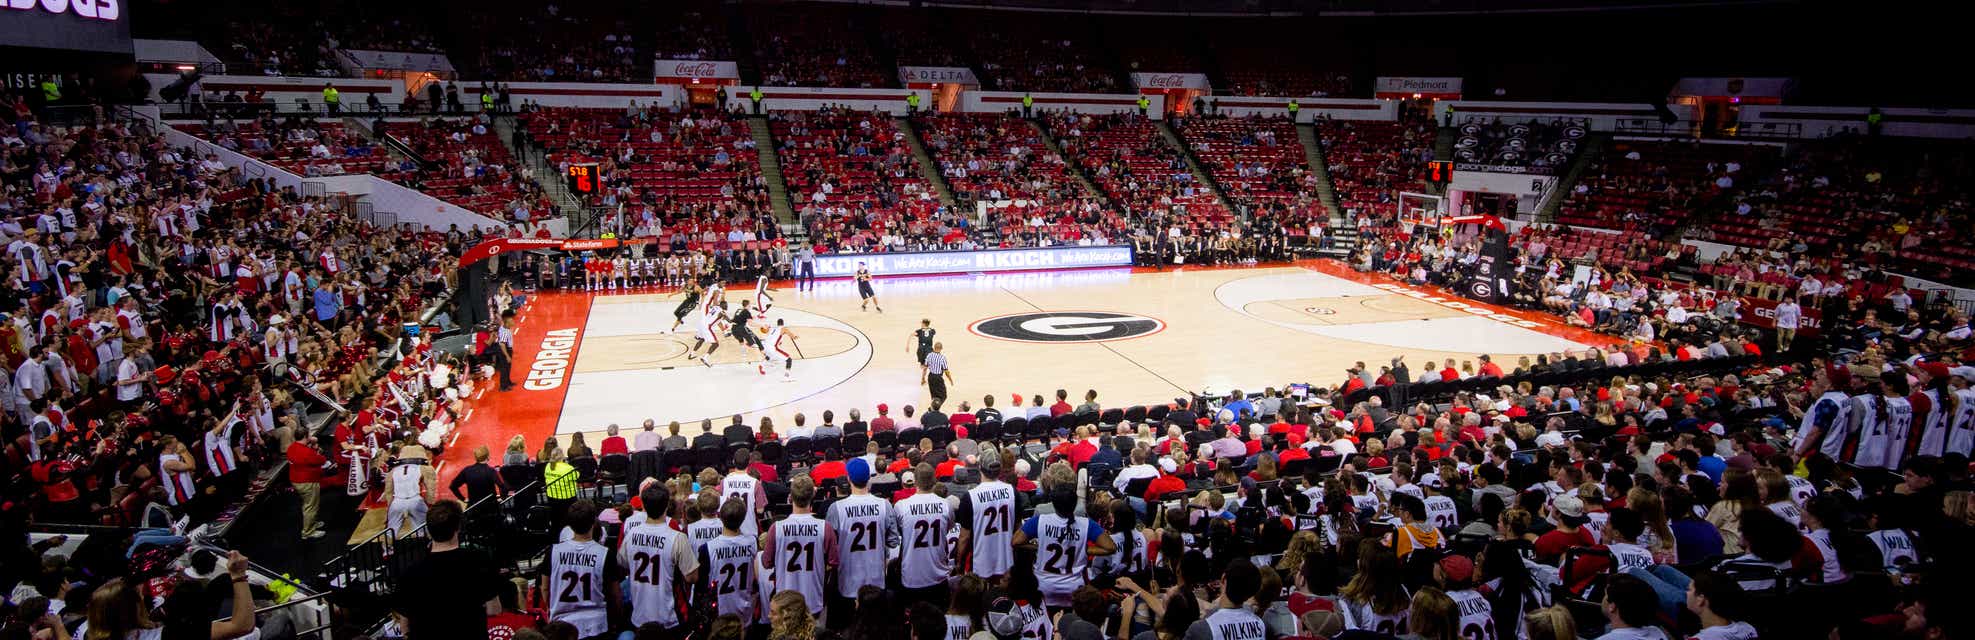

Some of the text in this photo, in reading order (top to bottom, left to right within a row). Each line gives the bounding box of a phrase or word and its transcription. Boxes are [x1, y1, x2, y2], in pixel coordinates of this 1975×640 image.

[921, 71, 963, 80] DELTA
[1404, 80, 1448, 89] Piedmont
[578, 176, 592, 192] 16
[1534, 183, 1542, 191] 2
[820, 257, 884, 273] KOCH
[997, 252, 1054, 267] KOCH
[523, 328, 579, 391] GEORGIA
[728, 481, 751, 489] WILKINS
[978, 488, 1010, 503] WILKINS
[845, 505, 880, 518] WILKINS
[910, 503, 943, 516] WILKINS
[984, 504, 1009, 536] 21
[695, 527, 723, 539] WILKIN
[783, 525, 818, 537] WILKINS
[850, 521, 878, 552] 21
[914, 519, 941, 548] 21
[631, 533, 667, 550] WILKINS
[716, 545, 752, 560] WILKINS
[786, 541, 815, 572] 21
[1044, 544, 1077, 574] 21
[559, 553, 597, 569] WILKINS
[634, 552, 661, 586] 21
[559, 570, 592, 602] 21
[720, 563, 749, 594] 21
[1220, 621, 1262, 640] WILKINS
